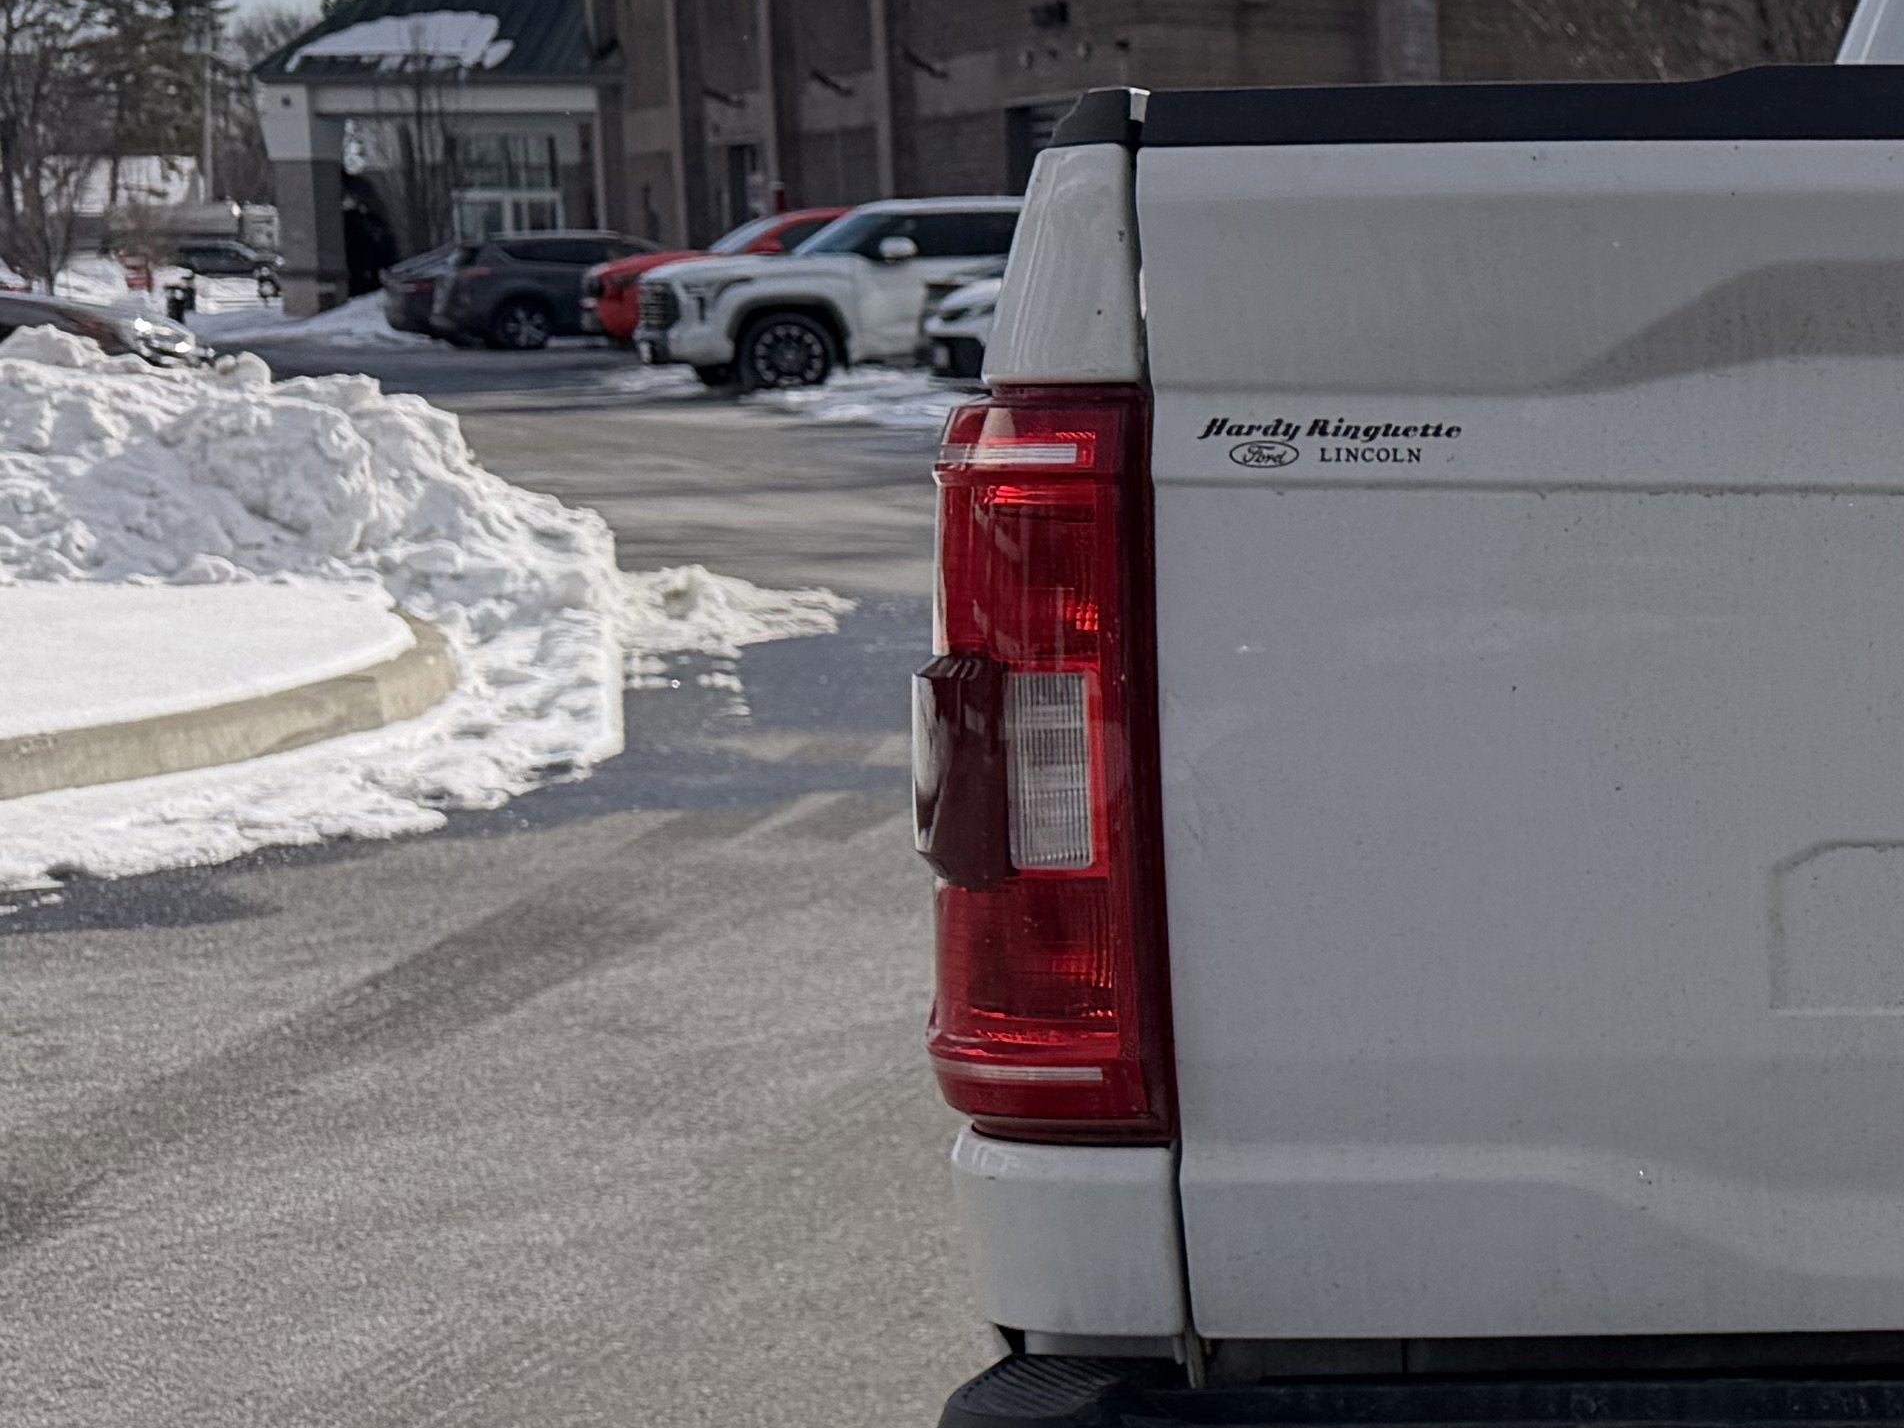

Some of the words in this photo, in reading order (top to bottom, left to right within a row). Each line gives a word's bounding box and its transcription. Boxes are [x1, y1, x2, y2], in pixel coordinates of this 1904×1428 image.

[1197, 417, 1302, 442] Hardy
[1306, 417, 1463, 443] Ringuette
[1242, 445, 1288, 466] Ford
[1319, 447, 1422, 463] LINCOLN
